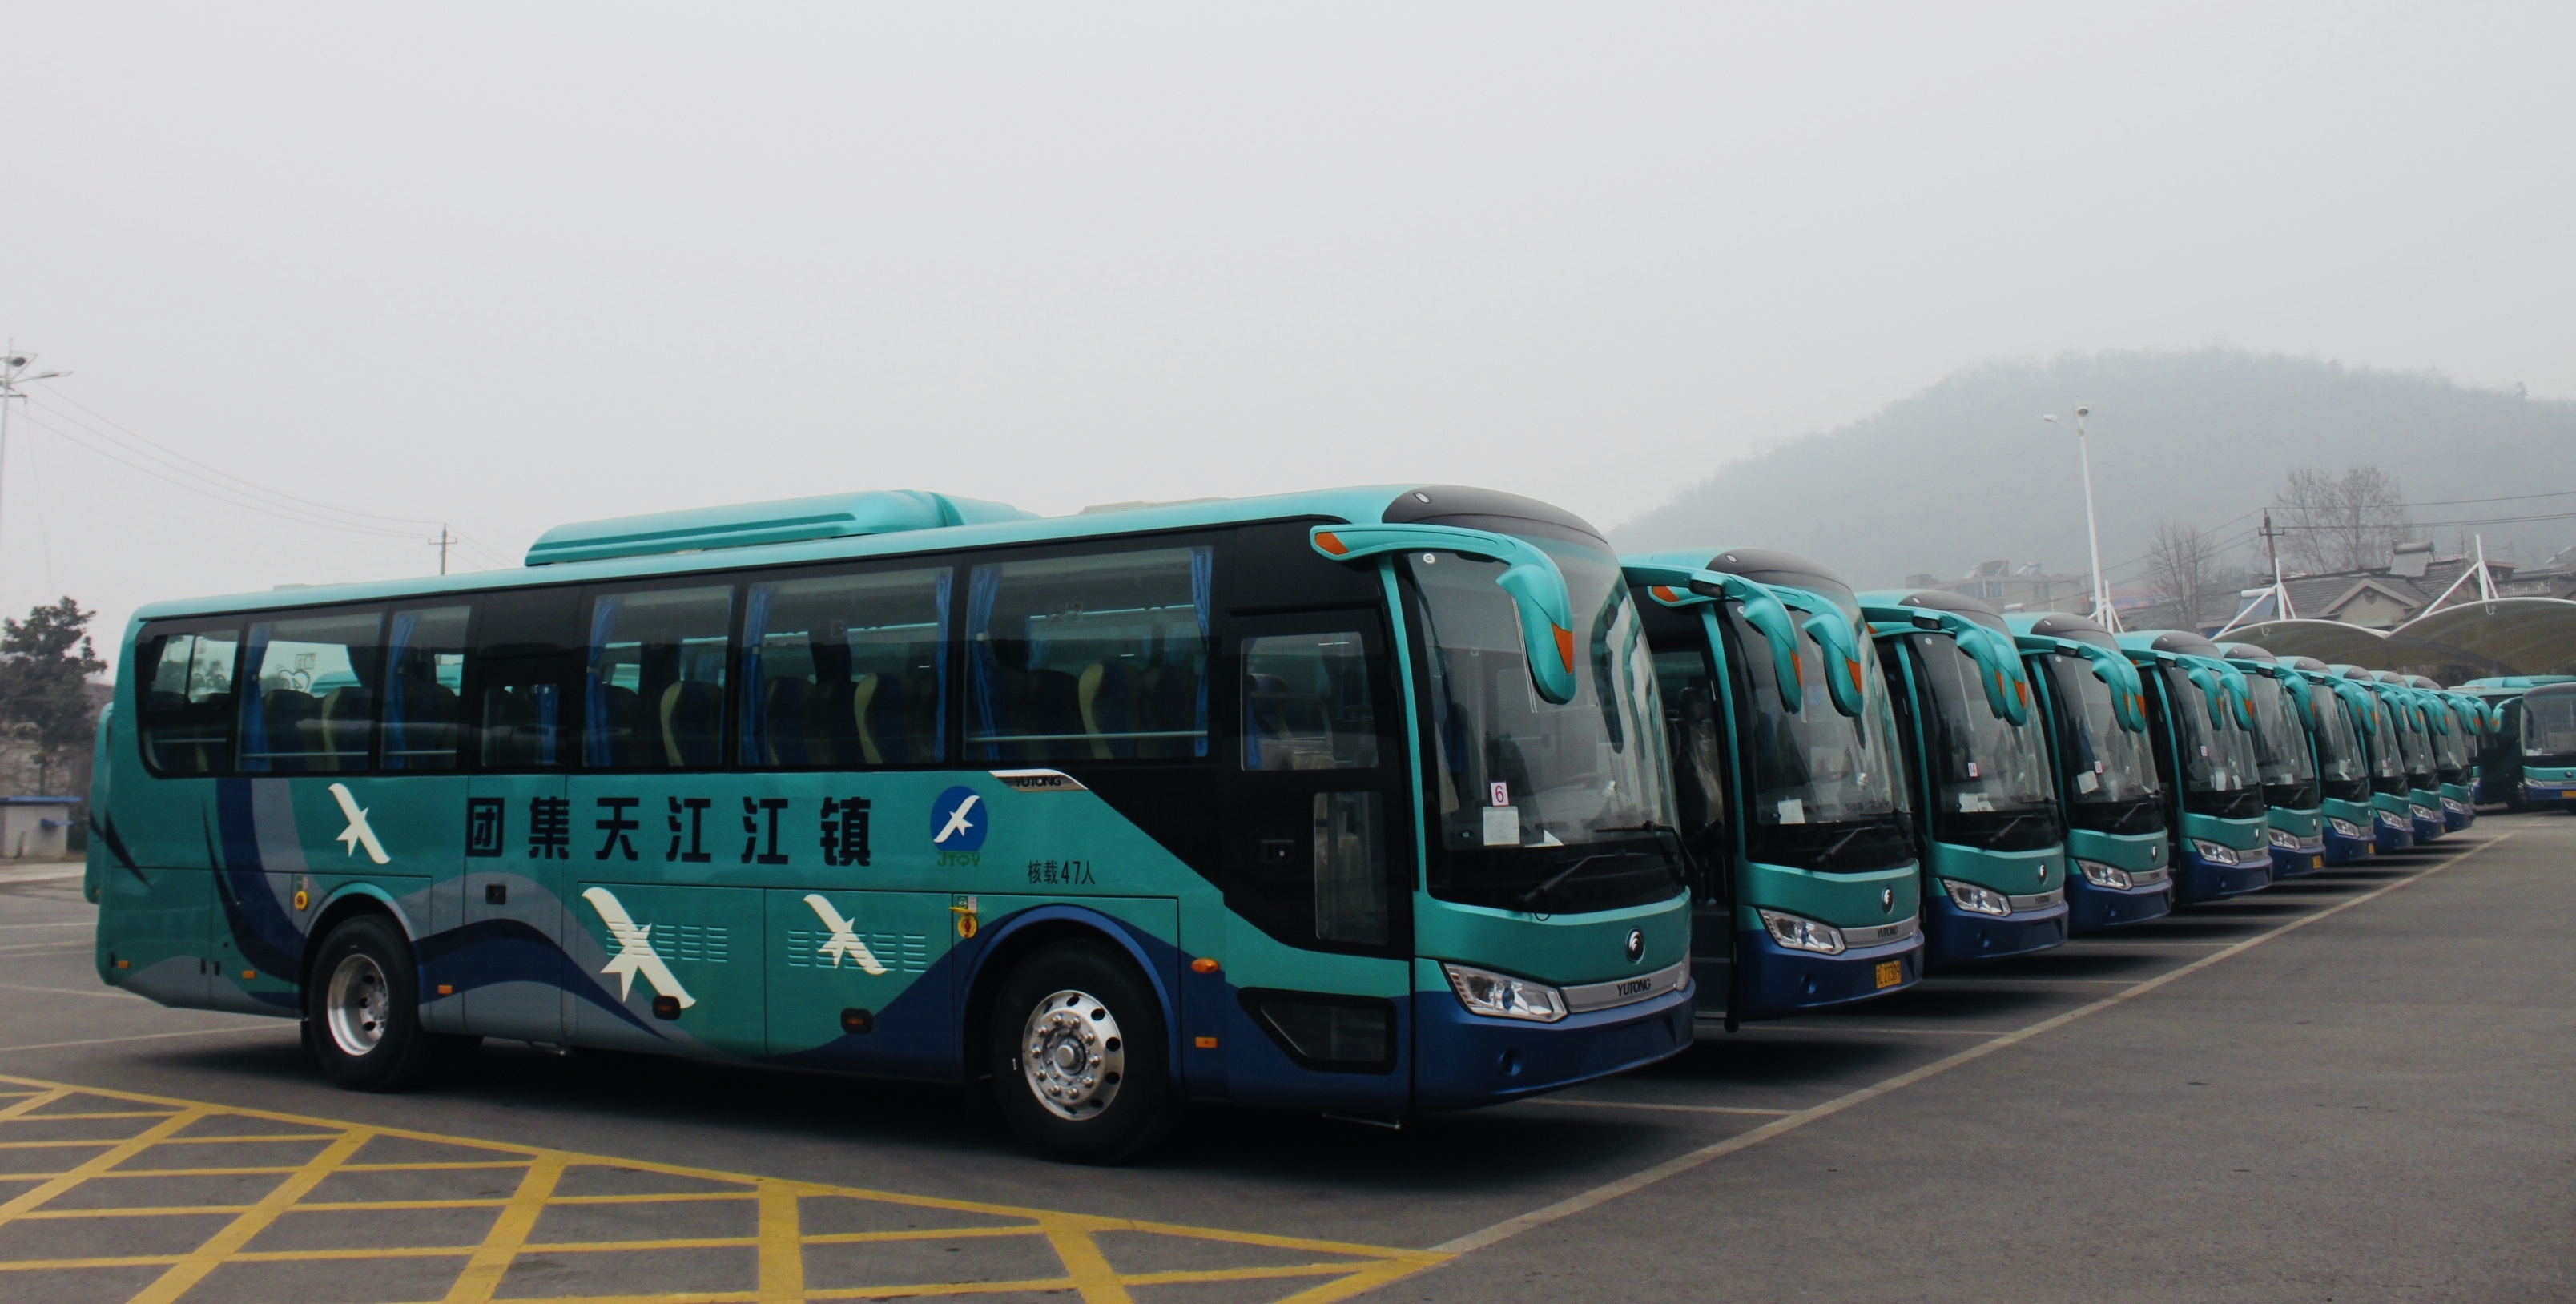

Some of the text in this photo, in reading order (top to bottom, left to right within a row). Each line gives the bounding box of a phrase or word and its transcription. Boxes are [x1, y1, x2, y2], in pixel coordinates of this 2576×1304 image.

[1016, 776, 1061, 787] YUTONG
[1495, 785, 1504, 803] 6
[1027, 859, 1096, 885] 核载47人
[1617, 978, 1652, 996] YUTONG
